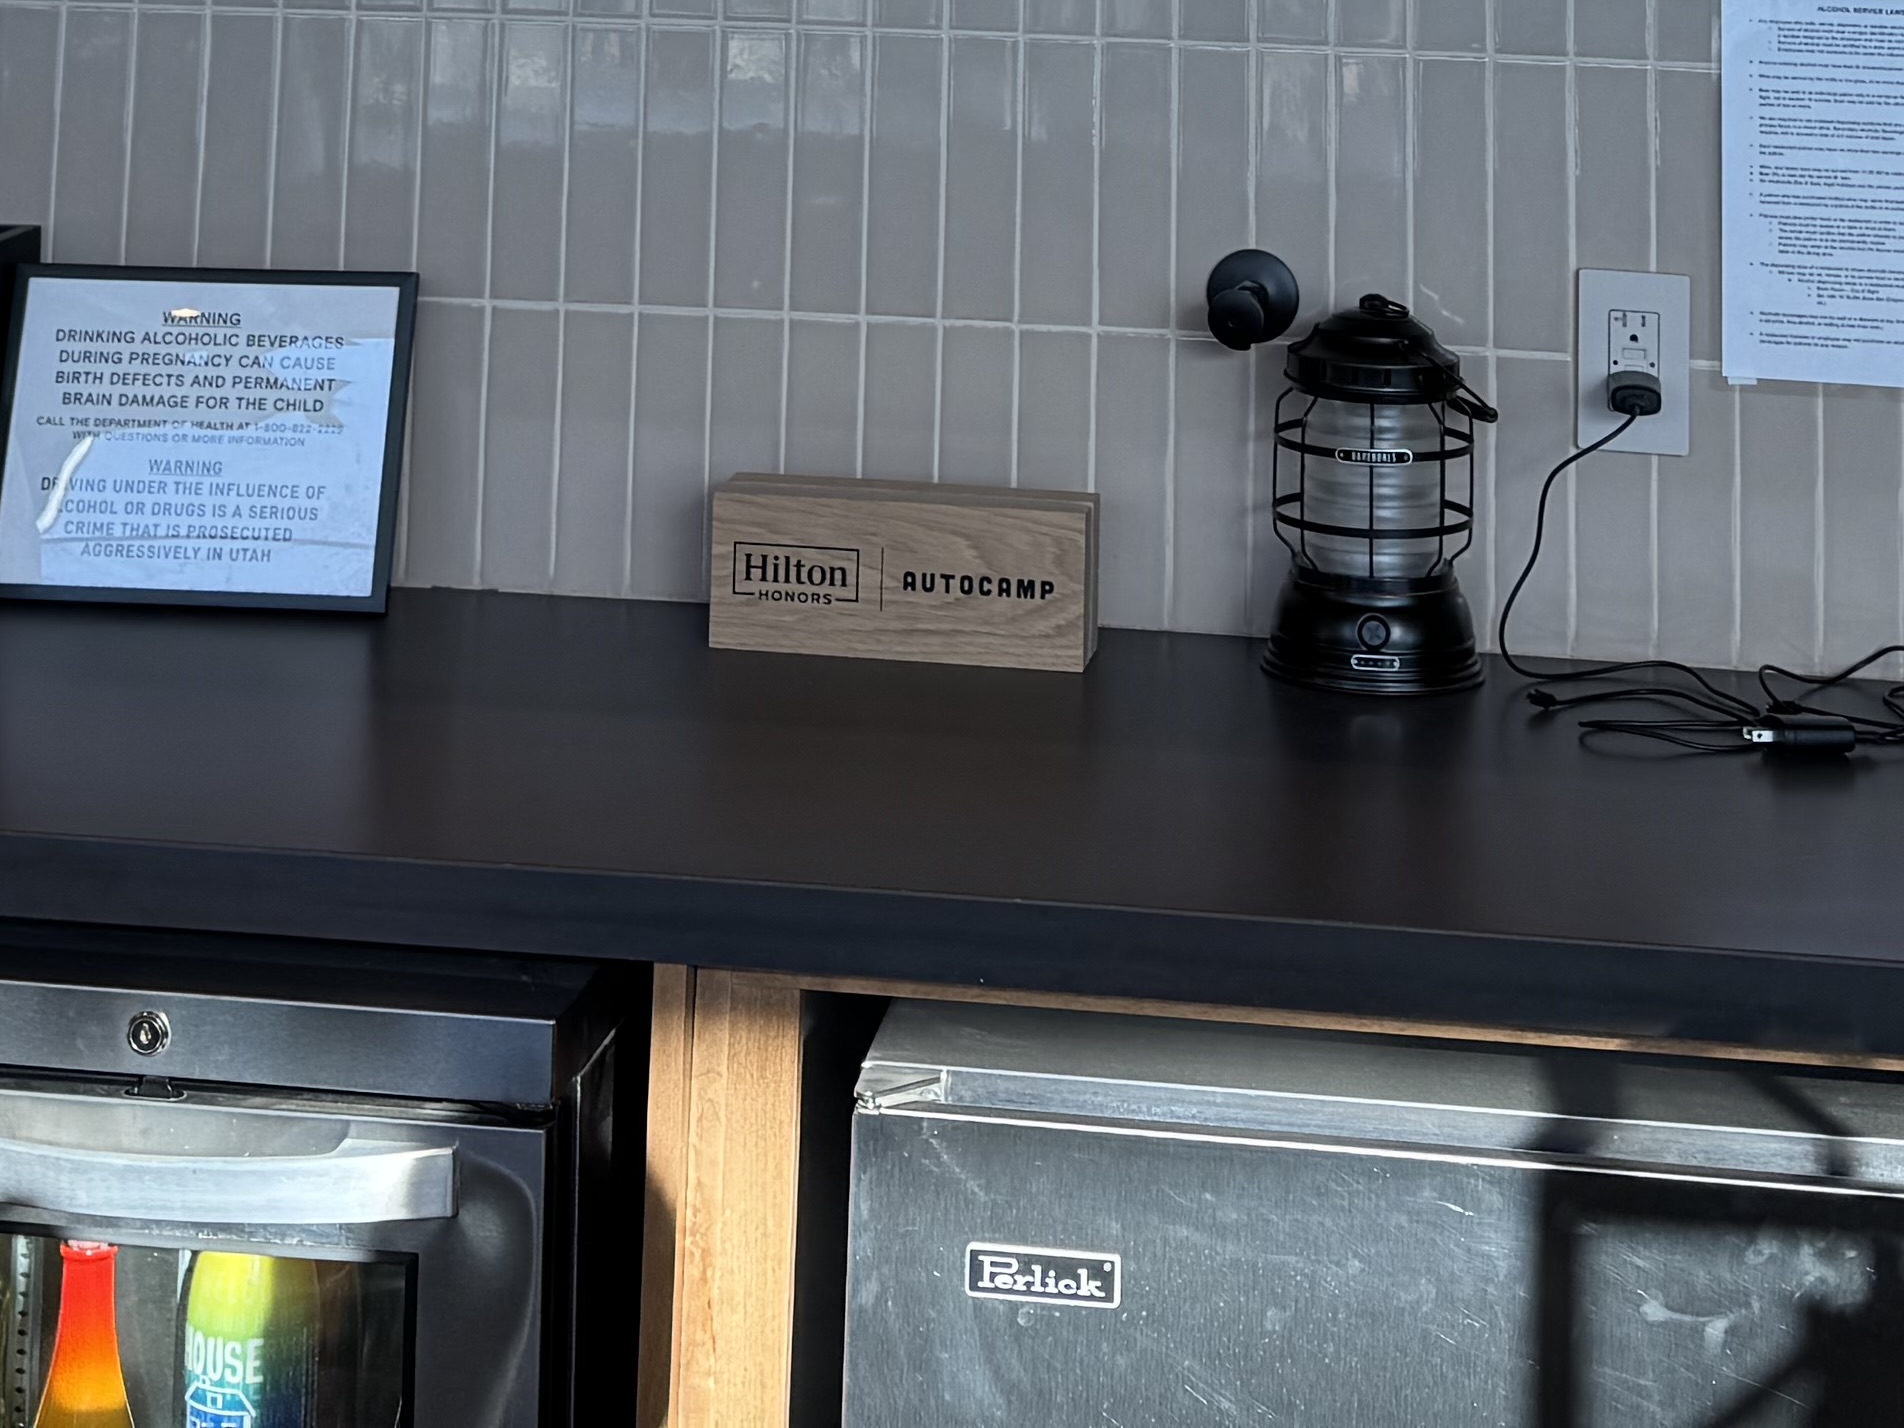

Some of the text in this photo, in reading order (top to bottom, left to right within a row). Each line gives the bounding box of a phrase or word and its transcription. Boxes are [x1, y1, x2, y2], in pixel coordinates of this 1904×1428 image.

[162, 311, 241, 327] WARNING
[55, 329, 344, 350] DRINKING ALCOHOLIC BEVERAGES
[59, 350, 336, 371] DURING PREGNANCY CAN CAUSE
[55, 371, 336, 392] BIRTH DEFECTS AND PERMANENT
[62, 392, 324, 412] BRAIN DAMAGE FOR THE CHILD
[36, 416, 65, 426] CALL
[70, 417, 91, 427] THE
[93, 418, 167, 429] DEPARTMENT
[191, 420, 233, 431] HEALTH
[236, 422, 250, 430] AT
[172, 434, 188, 442] OR
[192, 434, 225, 444] MORE
[228, 436, 305, 447] INFORMATION
[149, 459, 222, 476] WARNING
[41, 477, 326, 500] DRVING UNDER THE INFLUENCE OF
[59, 499, 318, 521] COHOL OR DRUGS IS A SERIOUS
[64, 521, 293, 542] CRIME THAT IS PROSECUTED
[80, 544, 271, 563] AGGRESSIVELY IN UTAH
[743, 552, 1055, 600] Hilton AUTOCAMP
[758, 589, 833, 605] HONORS
[977, 1255, 1105, 1297] Perlick
